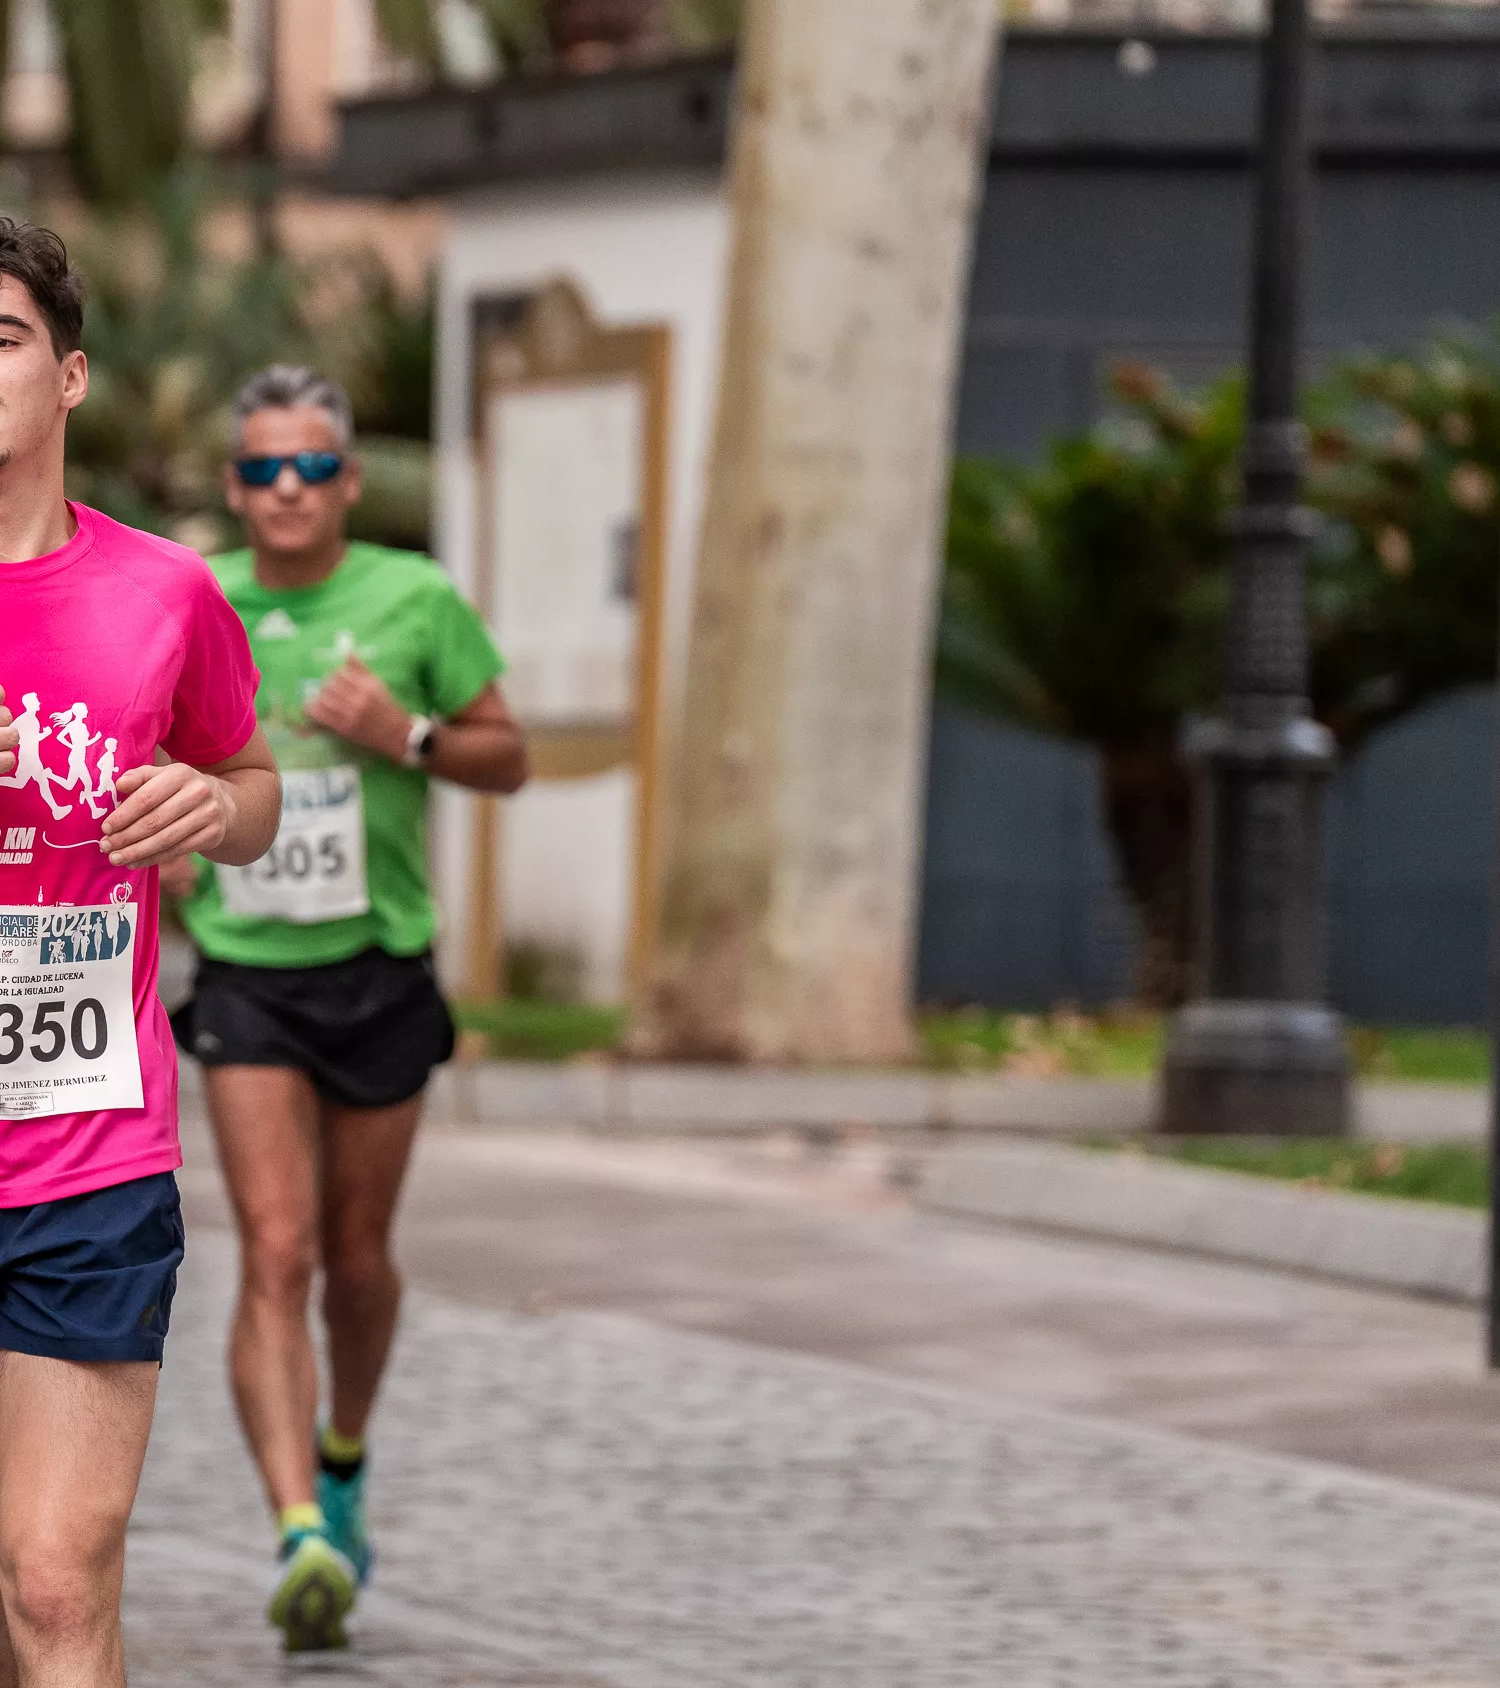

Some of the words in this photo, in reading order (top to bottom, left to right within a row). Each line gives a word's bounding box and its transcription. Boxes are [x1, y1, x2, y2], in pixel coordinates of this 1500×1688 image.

[3, 827, 37, 850] KM
[27, 917, 38, 926] DE
[40, 912, 92, 937] 2024
[11, 975, 41, 984] CIUDAD
[43, 973, 53, 982] DE
[54, 972, 84, 981] LUCENA
[11, 988, 22, 996] LA
[24, 986, 64, 995] IGUALDAD
[11, 1079, 51, 1090] JIMENEZ
[53, 1074, 107, 1087] BERMUDEZ
